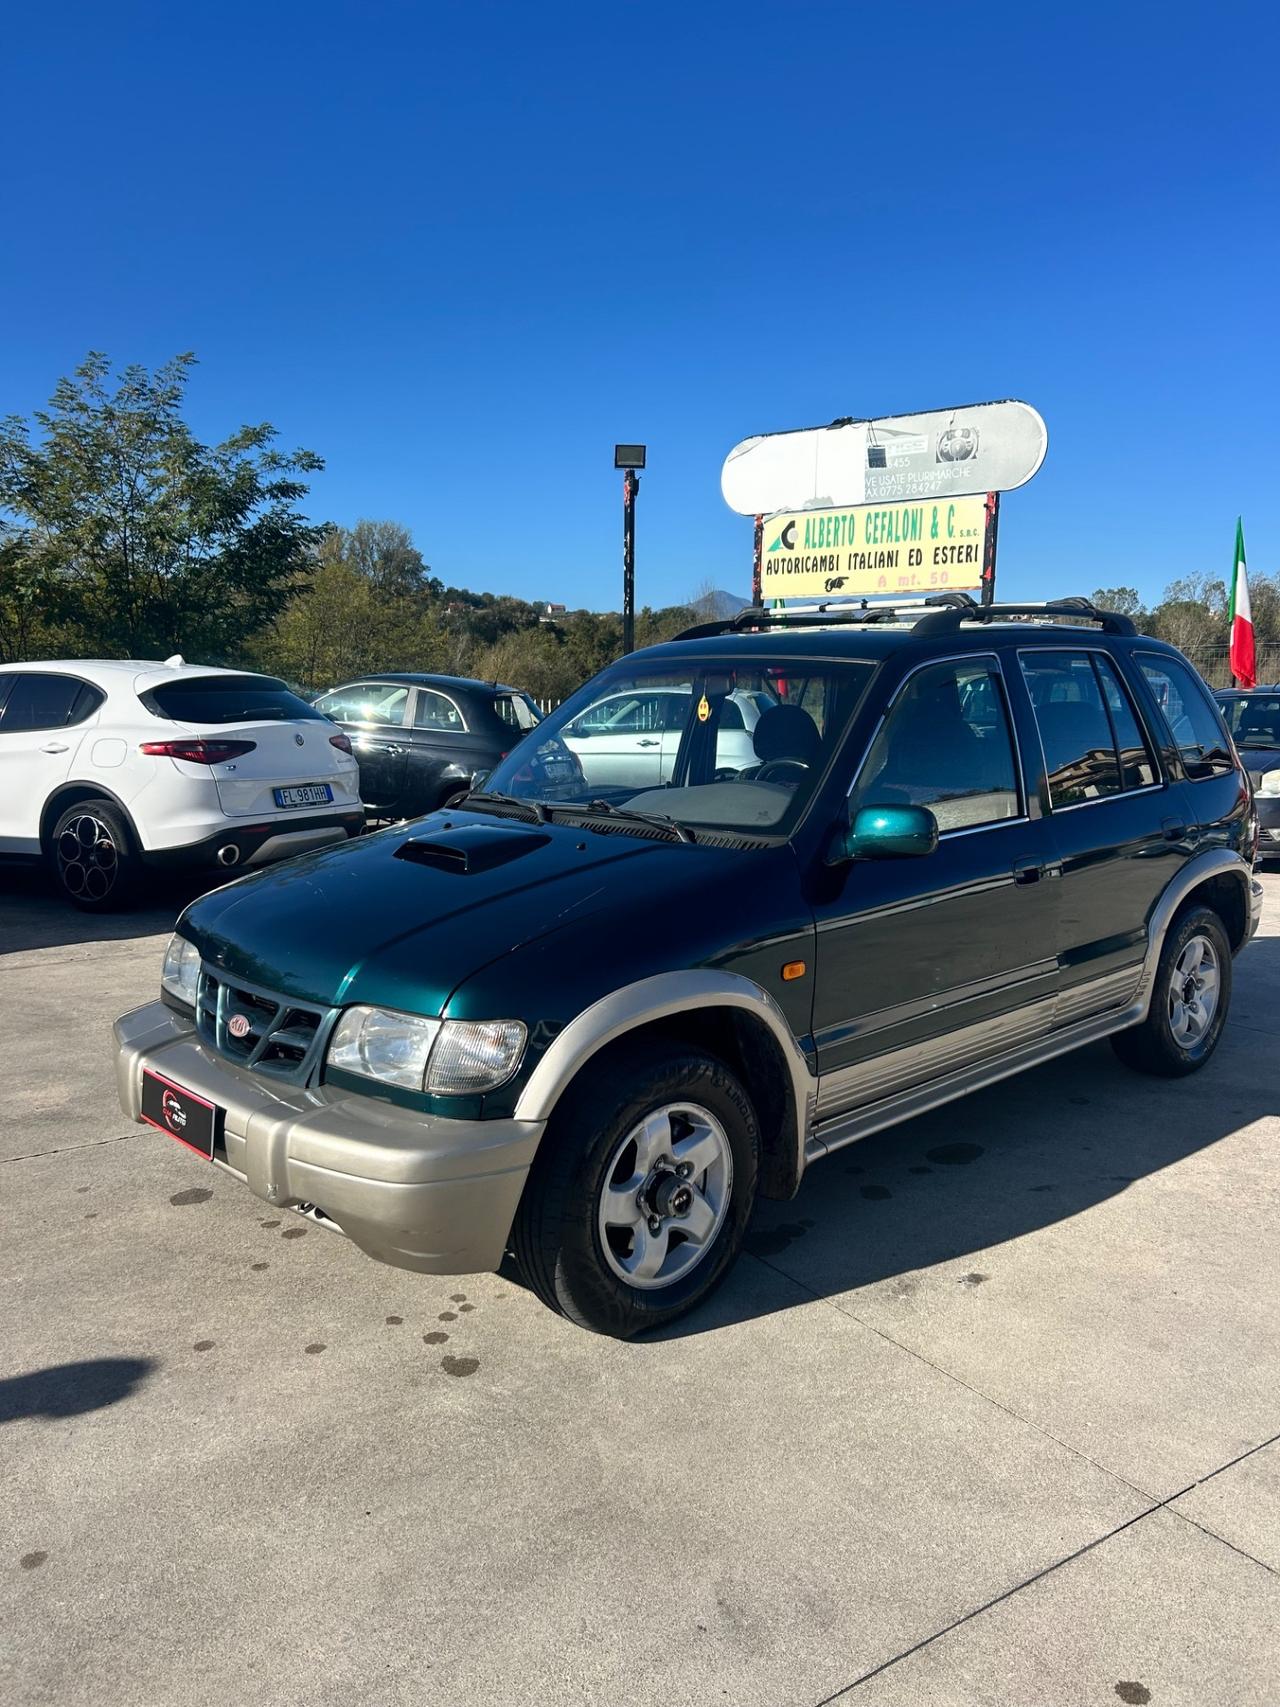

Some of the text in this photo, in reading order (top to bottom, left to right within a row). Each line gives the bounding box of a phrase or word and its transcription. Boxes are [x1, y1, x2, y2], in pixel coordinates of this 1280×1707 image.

[879, 473, 905, 486] USATE
[907, 467, 971, 482] PLURIMARCHE
[880, 484, 902, 496] 0775
[906, 480, 942, 494] 284247
[804, 514, 855, 550] ALBERTO
[865, 508, 924, 545] CEFALONI
[930, 506, 939, 540] &
[766, 543, 979, 576] AUTORICAMBI ITALIANI ED ESTERI
[878, 575, 887, 588] A
[930, 571, 949, 585] 50
[282, 787, 327, 804] FL 981HH
